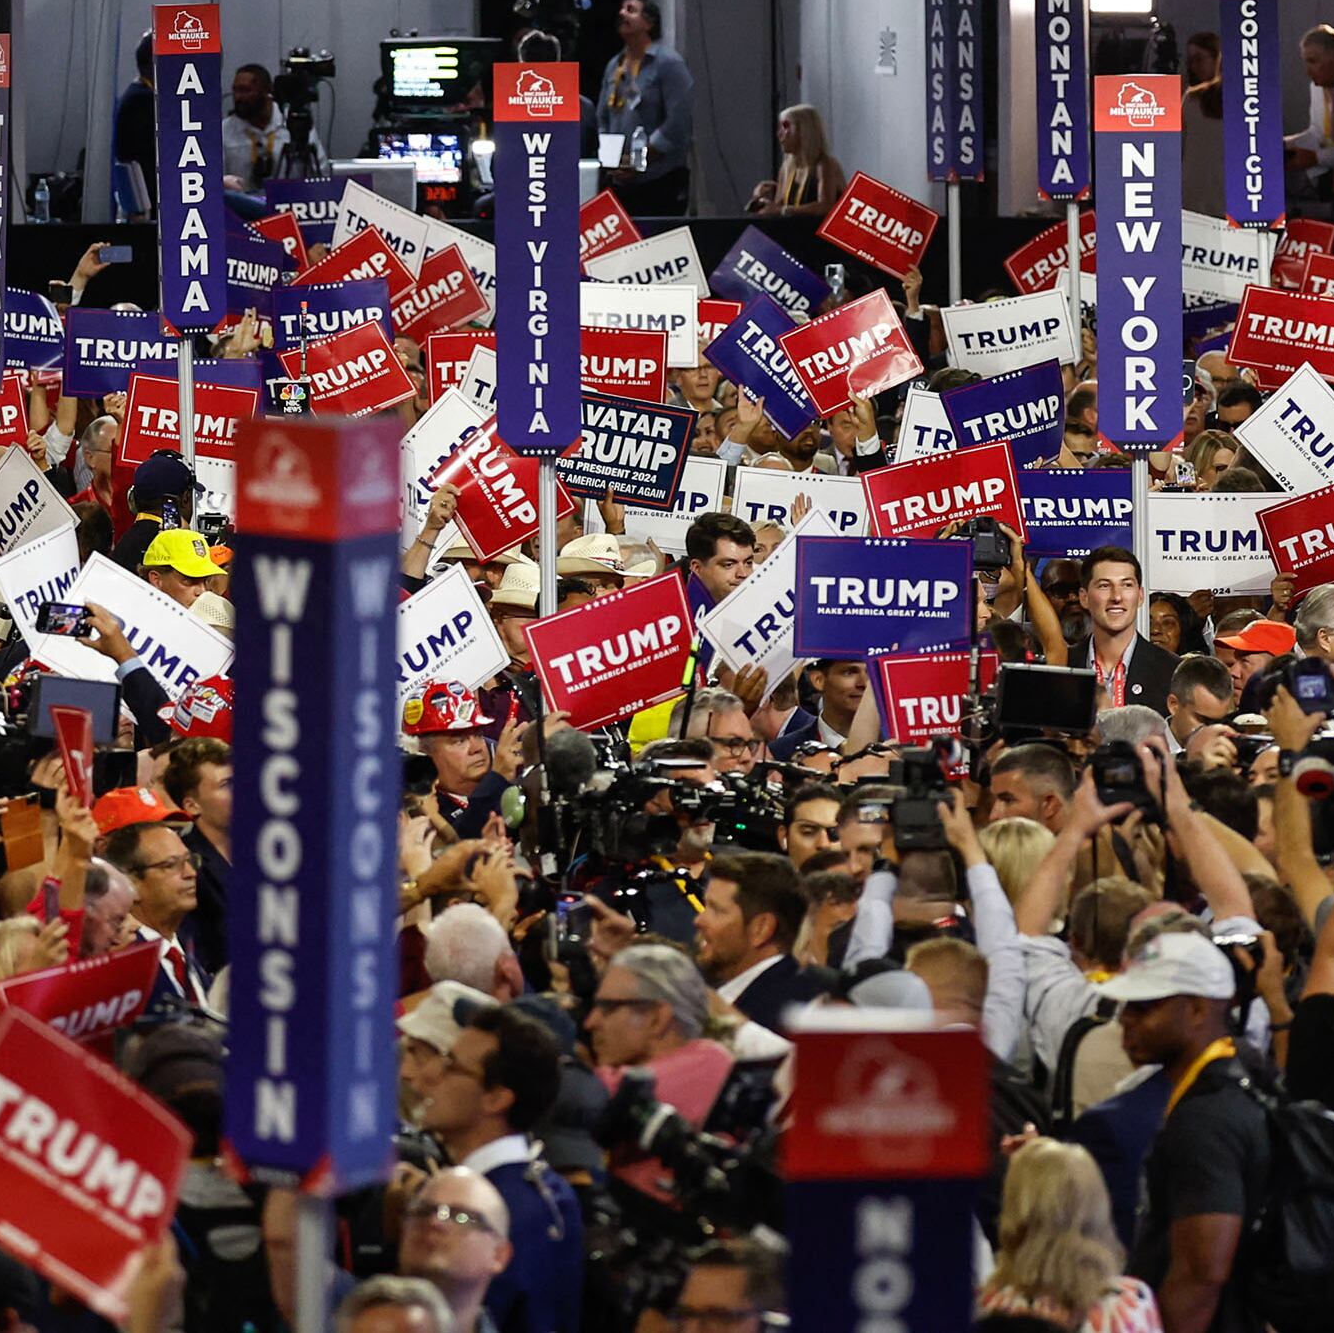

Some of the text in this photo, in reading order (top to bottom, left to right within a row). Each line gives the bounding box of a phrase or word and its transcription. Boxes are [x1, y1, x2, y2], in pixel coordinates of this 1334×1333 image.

[168, 32, 210, 41] MILWAUKEE
[508, 95, 564, 105] MILWAUKEE
[1110, 107, 1166, 116] MILWAUKEE
[1241, 0, 1262, 213] CONNECTICUT
[175, 63, 210, 313] ALABAMA
[848, 198, 923, 247] TRUMP
[227, 258, 278, 285] TRUMP
[521, 133, 552, 435] WEST VIRGINIA
[738, 251, 810, 310] TRUMP
[1116, 142, 1162, 432] NEW YORK
[391, 270, 464, 327] TRUMP
[798, 324, 892, 378] TRUMP
[958, 319, 1061, 350] TRUMP
[581, 403, 673, 440] VATAR
[966, 395, 1059, 443] TRUMP
[555, 458, 657, 484] FOR PRESIDENT 2024
[581, 429, 676, 471] RUMP
[566, 475, 666, 500] AMERICA GREAT AGAIN
[880, 477, 1005, 526] TRUMP
[1275, 472, 1294, 492] 2024
[892, 504, 1002, 534] MAKE AMERICA GREAT AGAIN!
[1292, 559, 1313, 570] MAKE
[810, 577, 958, 607] TRUMP
[817, 607, 950, 619] MAKE AMERICA GREAT AGAIN!
[549, 615, 681, 684] TRUMP
[567, 646, 680, 695] MAKE AMERICA GREAT AGAIN!
[619, 699, 644, 716] 2024
[253, 558, 312, 1143] WISCONSIN
[347, 557, 390, 1140] WISCONSIN
